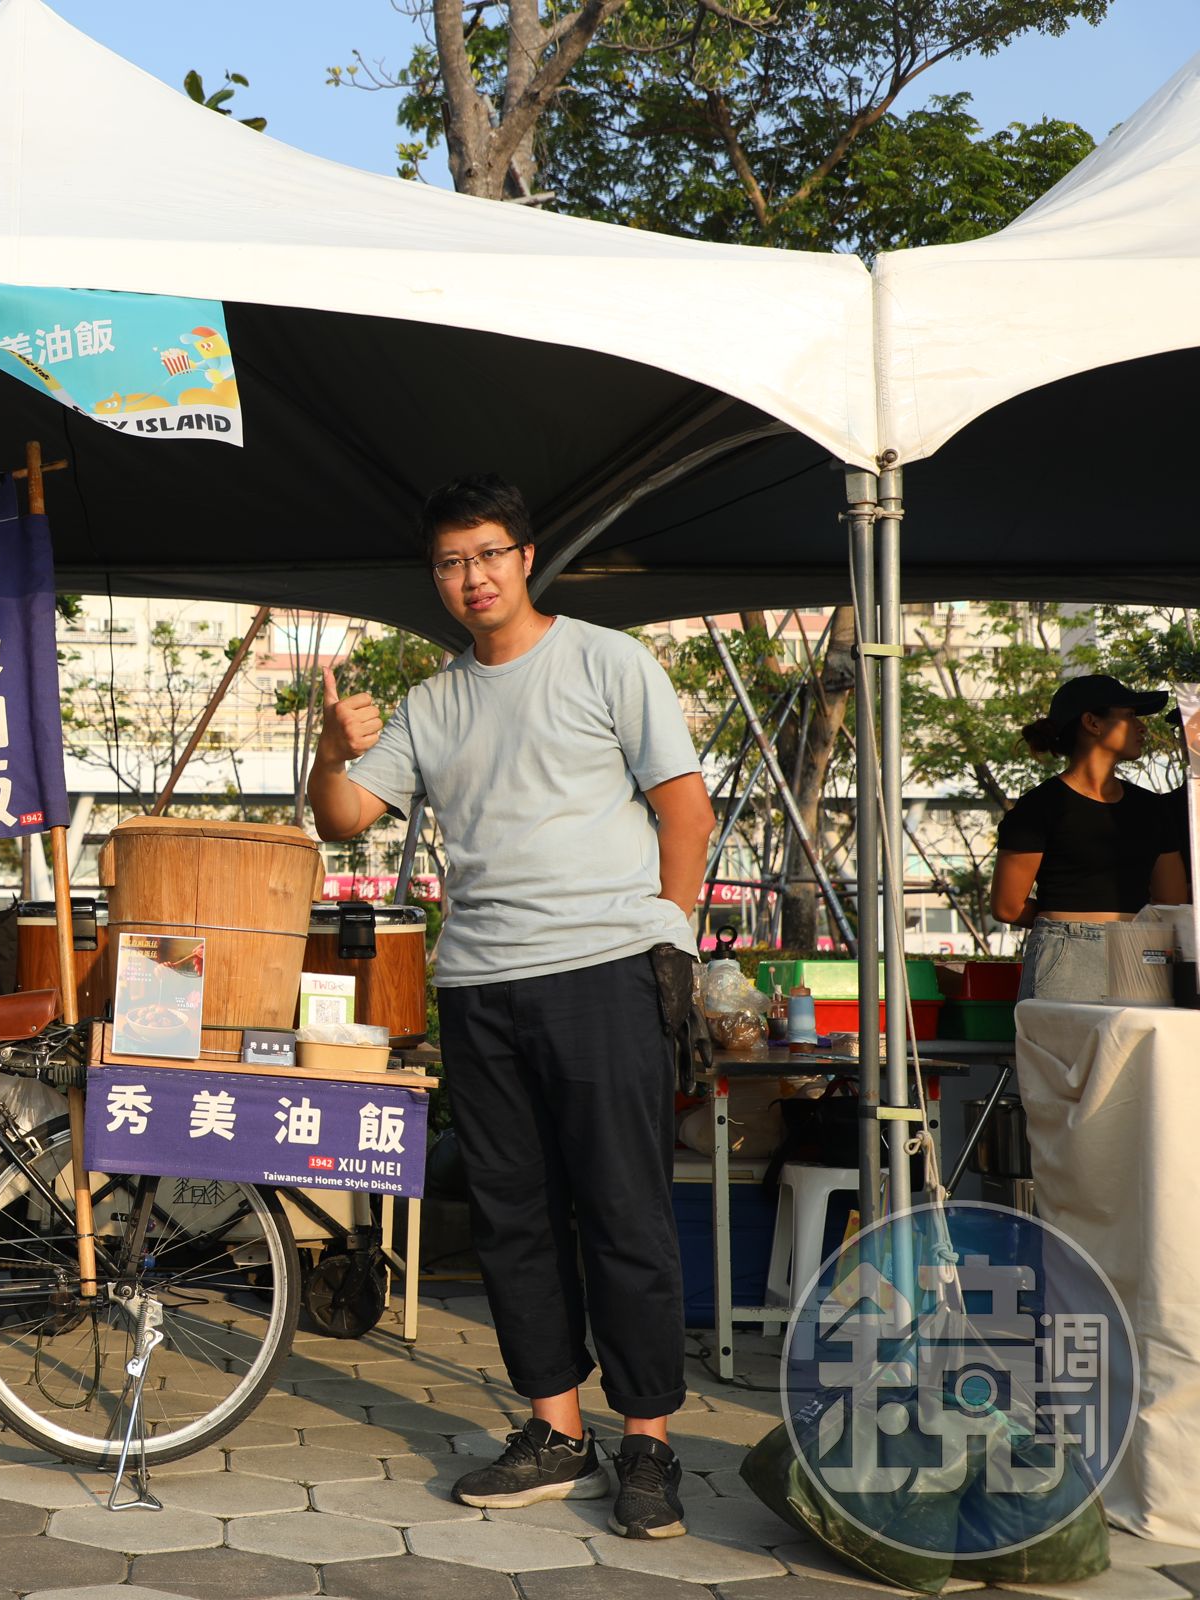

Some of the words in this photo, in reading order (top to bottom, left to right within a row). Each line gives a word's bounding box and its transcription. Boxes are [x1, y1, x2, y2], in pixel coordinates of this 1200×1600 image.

[136, 413, 232, 433] ISLAND
[21, 812, 43, 824] 1942
[250, 1041, 290, 1051] 秀美油飯
[106, 1083, 406, 1154] 秀美油飯
[310, 1157, 333, 1168] 1942
[338, 1157, 367, 1173] XIU
[371, 1160, 401, 1177] MEI
[263, 1171, 313, 1184] Taiwanese
[314, 1175, 342, 1186] Home
[344, 1177, 369, 1189] Style
[371, 1180, 403, 1192] Dishes
